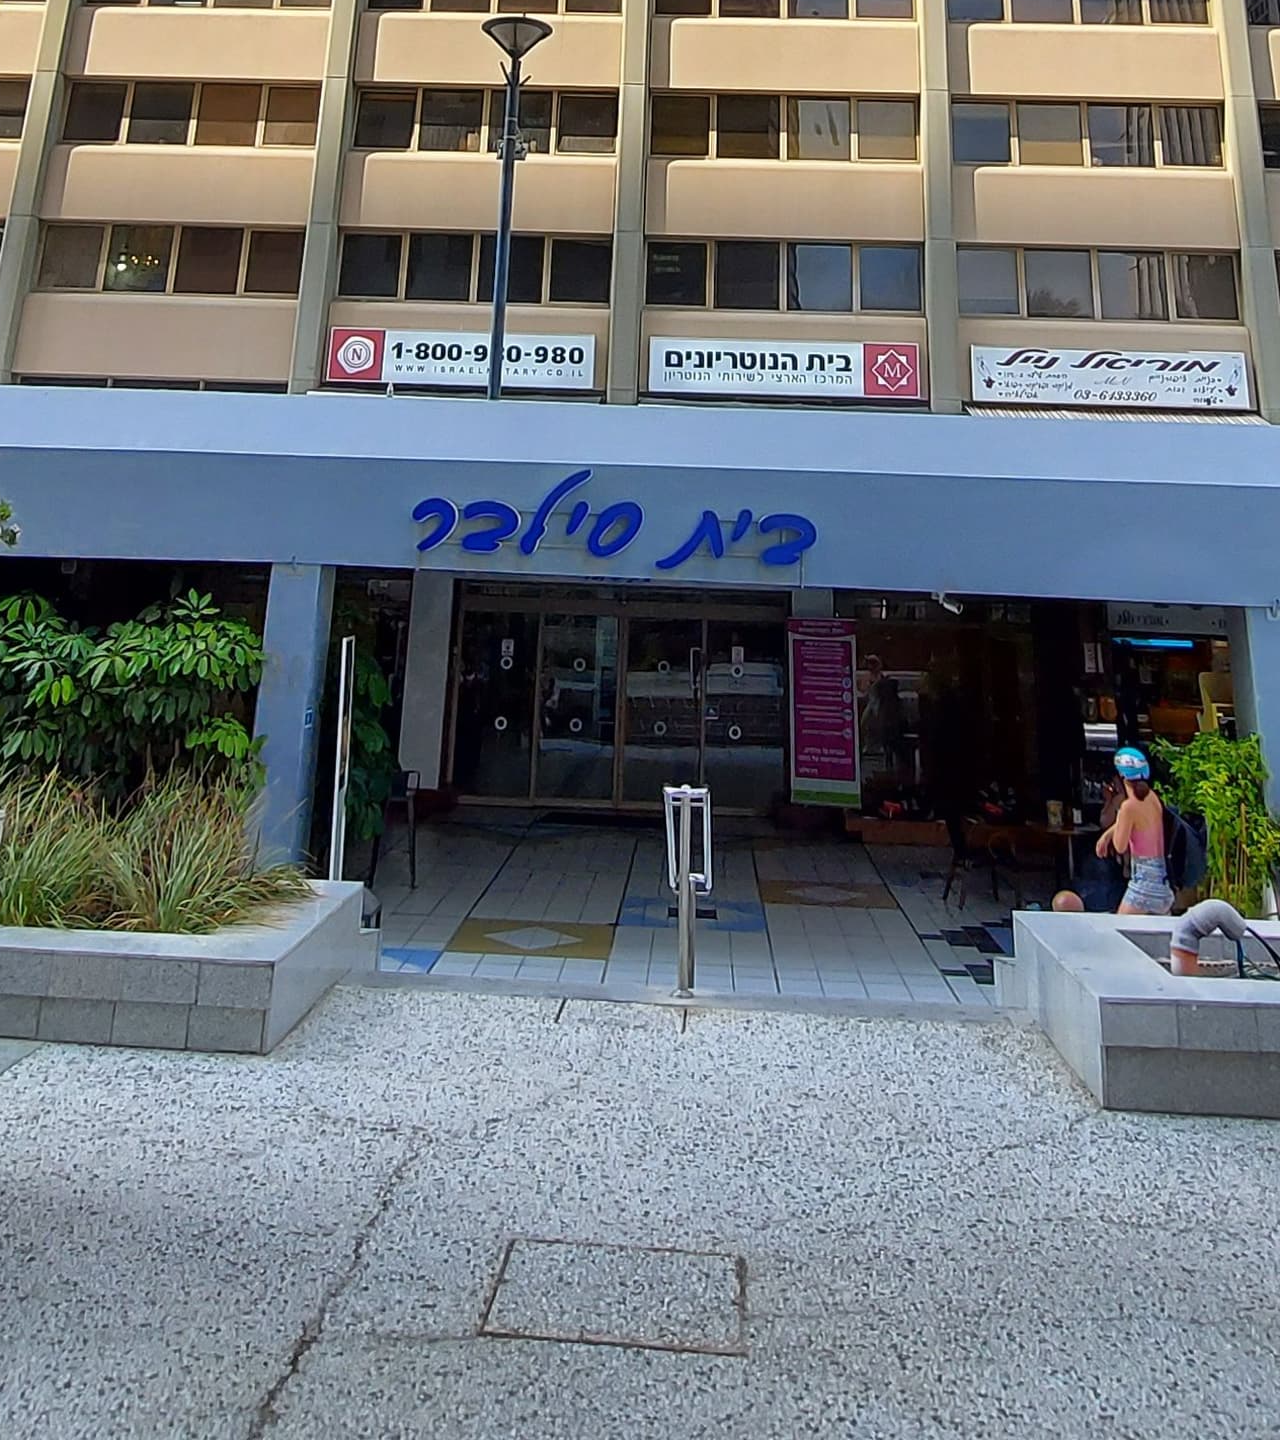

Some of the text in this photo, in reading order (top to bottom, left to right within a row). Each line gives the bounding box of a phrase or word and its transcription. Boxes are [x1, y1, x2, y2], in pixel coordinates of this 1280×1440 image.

[351, 347, 362, 360] N
[391, 342, 584, 364] 1-800-90-980
[664, 350, 852, 372] בית הנוטריונים
[1070, 351, 1221, 372] מוריאל
[395, 364, 584, 377] WWW.ISRAELNTARY.CO.IL
[664, 371, 853, 385] המרכז הארצי לשירותי הנוטריון
[883, 362, 902, 378] M
[411, 469, 818, 570] בית סילבר
